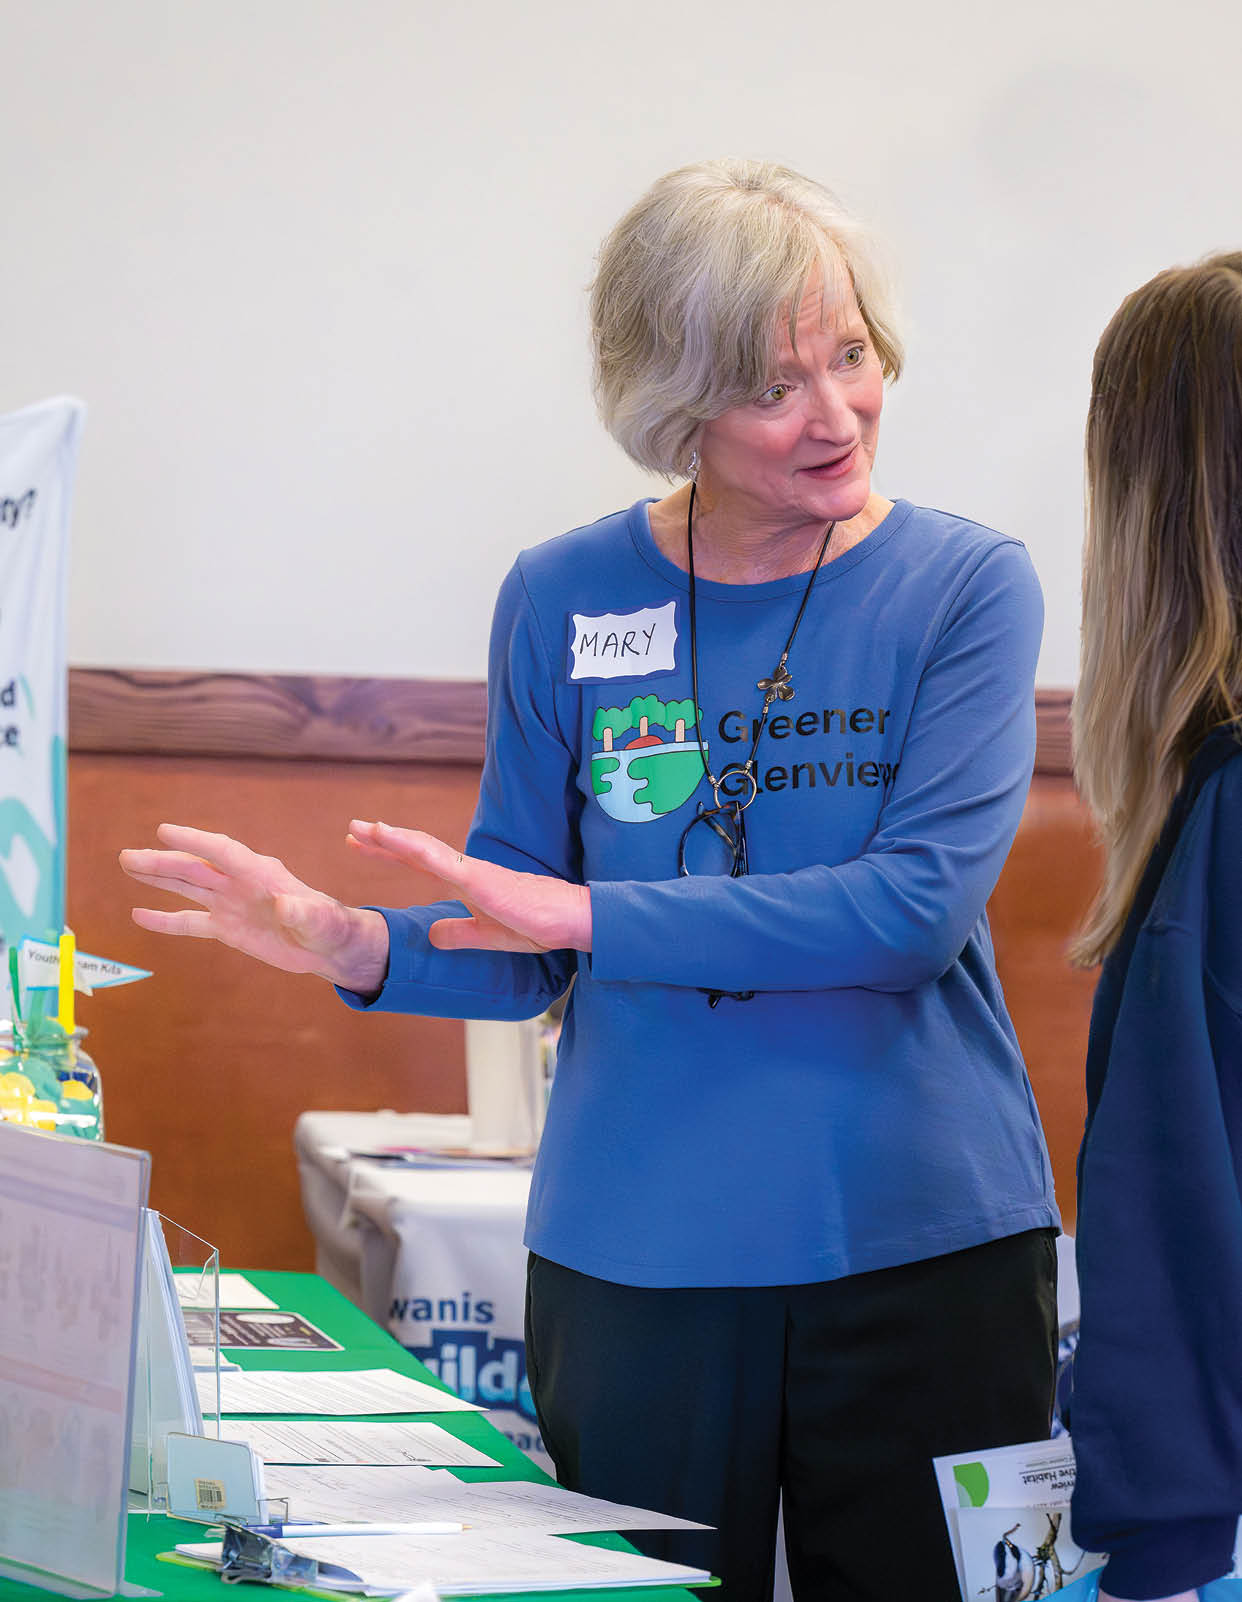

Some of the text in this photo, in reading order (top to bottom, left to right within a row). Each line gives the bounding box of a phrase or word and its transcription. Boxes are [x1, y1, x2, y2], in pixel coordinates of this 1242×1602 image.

[579, 623, 657, 658] MARY
[717, 707, 892, 744] Greener
[719, 751, 900, 797] Glenview
